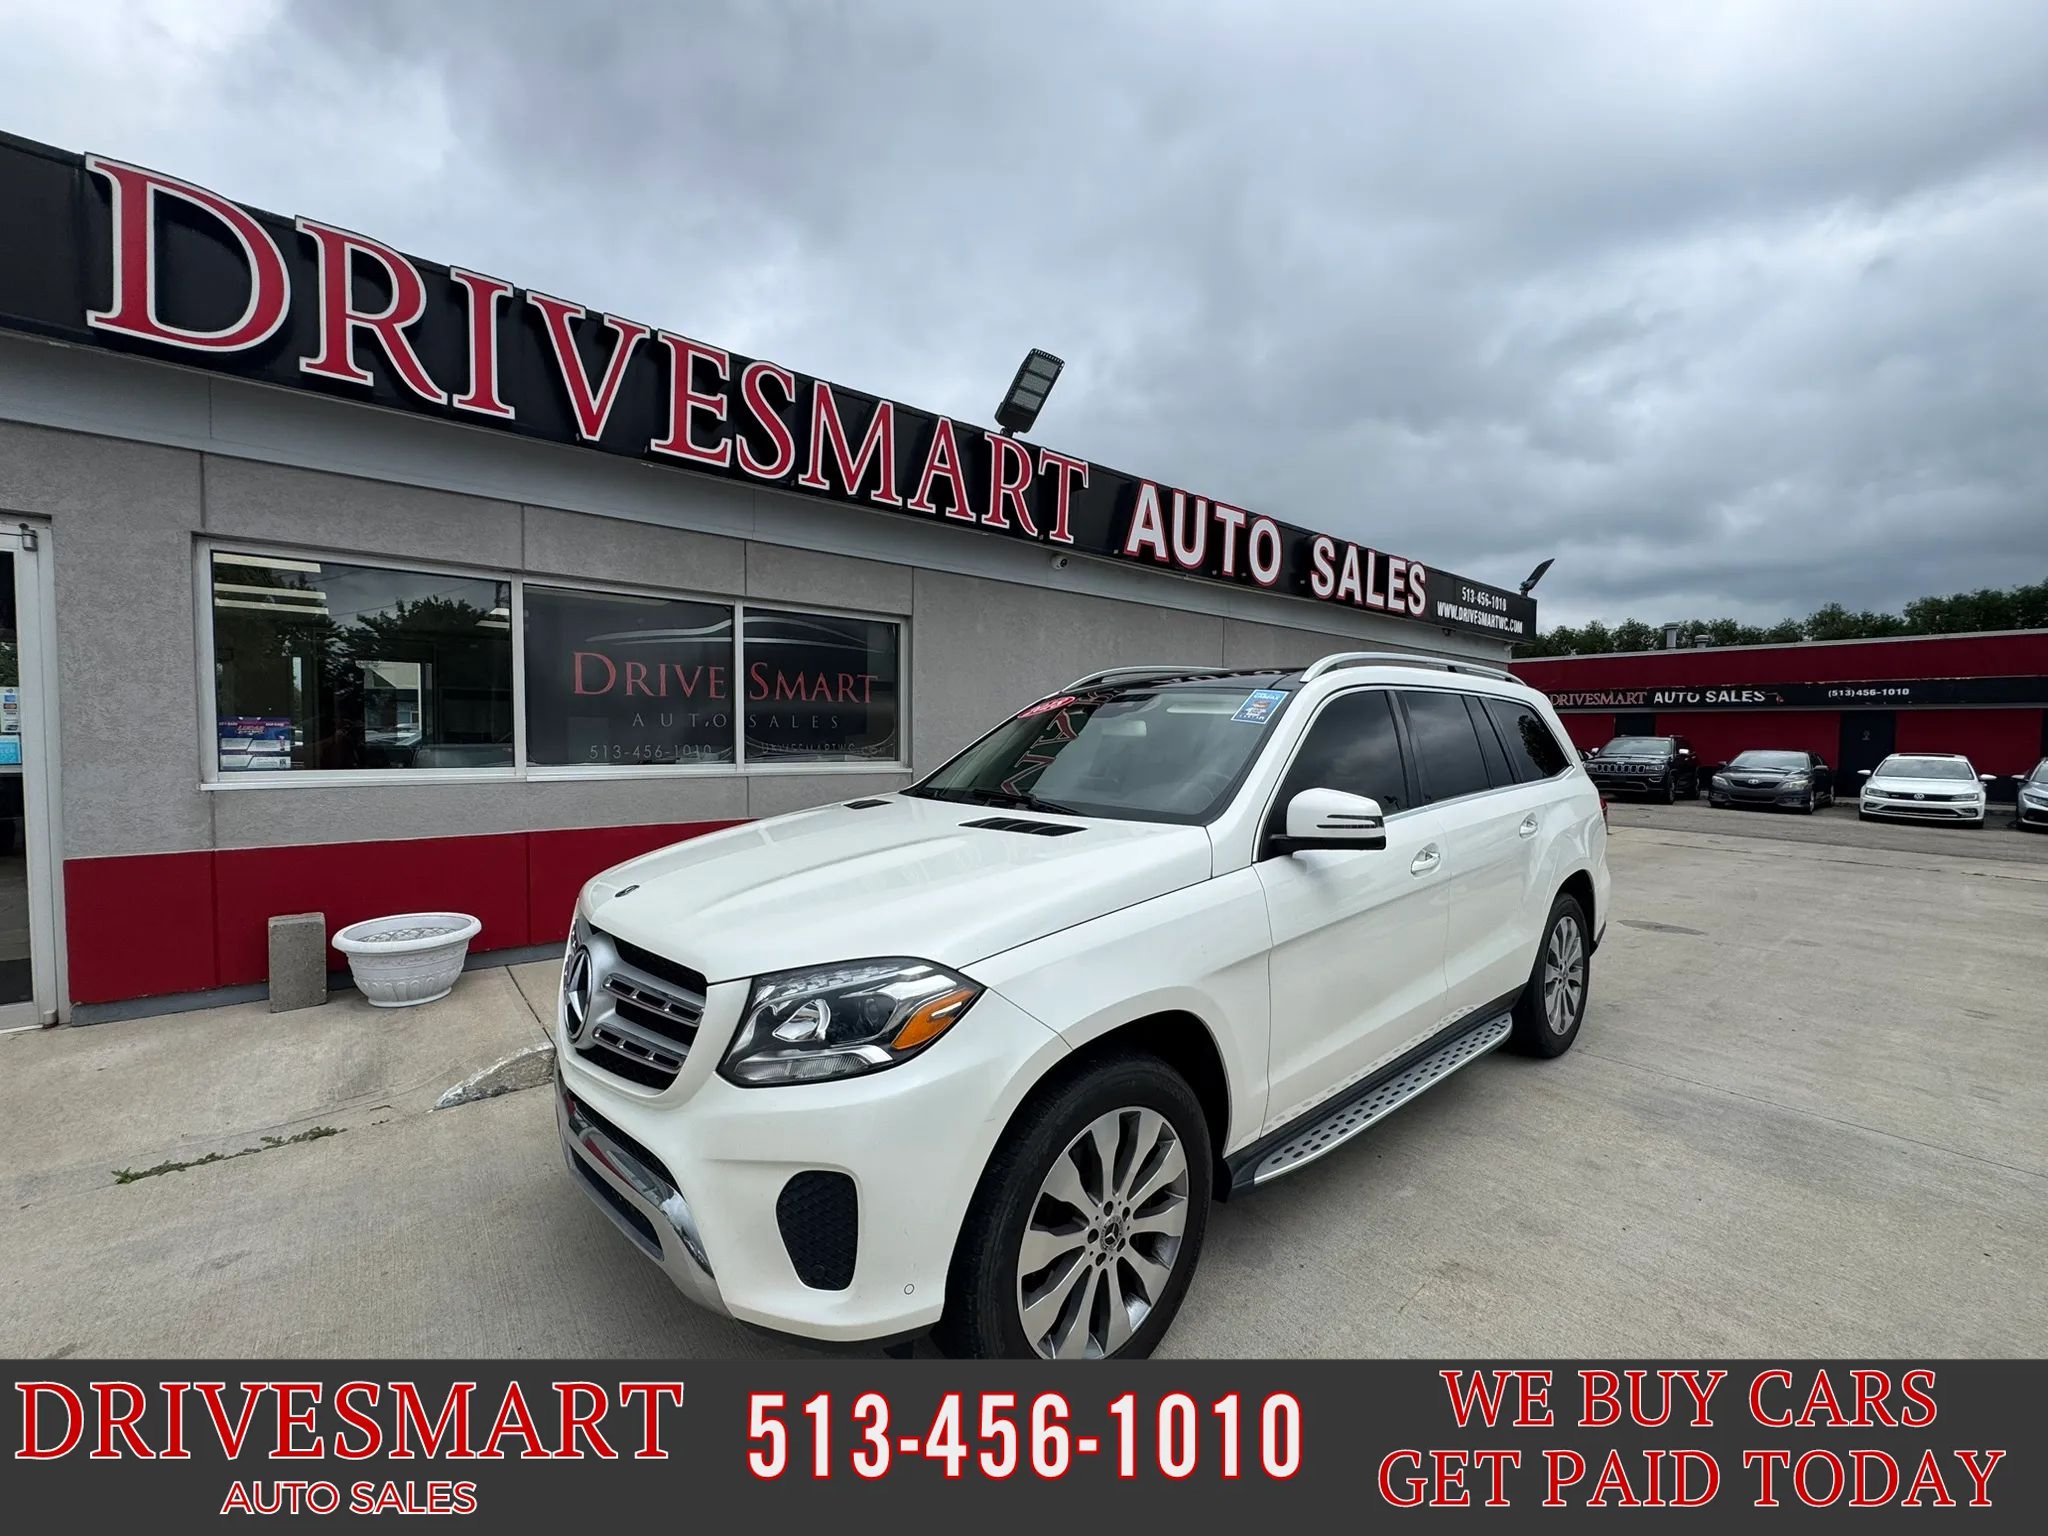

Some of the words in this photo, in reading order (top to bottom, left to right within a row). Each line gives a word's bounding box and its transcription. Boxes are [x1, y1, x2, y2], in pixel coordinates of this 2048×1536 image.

[85, 152, 1089, 545] DRIVESMART
[1124, 479, 1284, 587] AUTO
[1310, 533, 1427, 617] SALES
[1461, 586, 1507, 612] 513-456-1010
[1437, 600, 1523, 634] WWW.DRIVESMARTWC.COM
[573, 651, 727, 699] DRIVE
[749, 661, 879, 704] SMART
[1653, 691, 1700, 704] AUTO
[1705, 689, 1766, 703] SALES
[632, 712, 727, 728] AUTO
[749, 715, 839, 729] SALES
